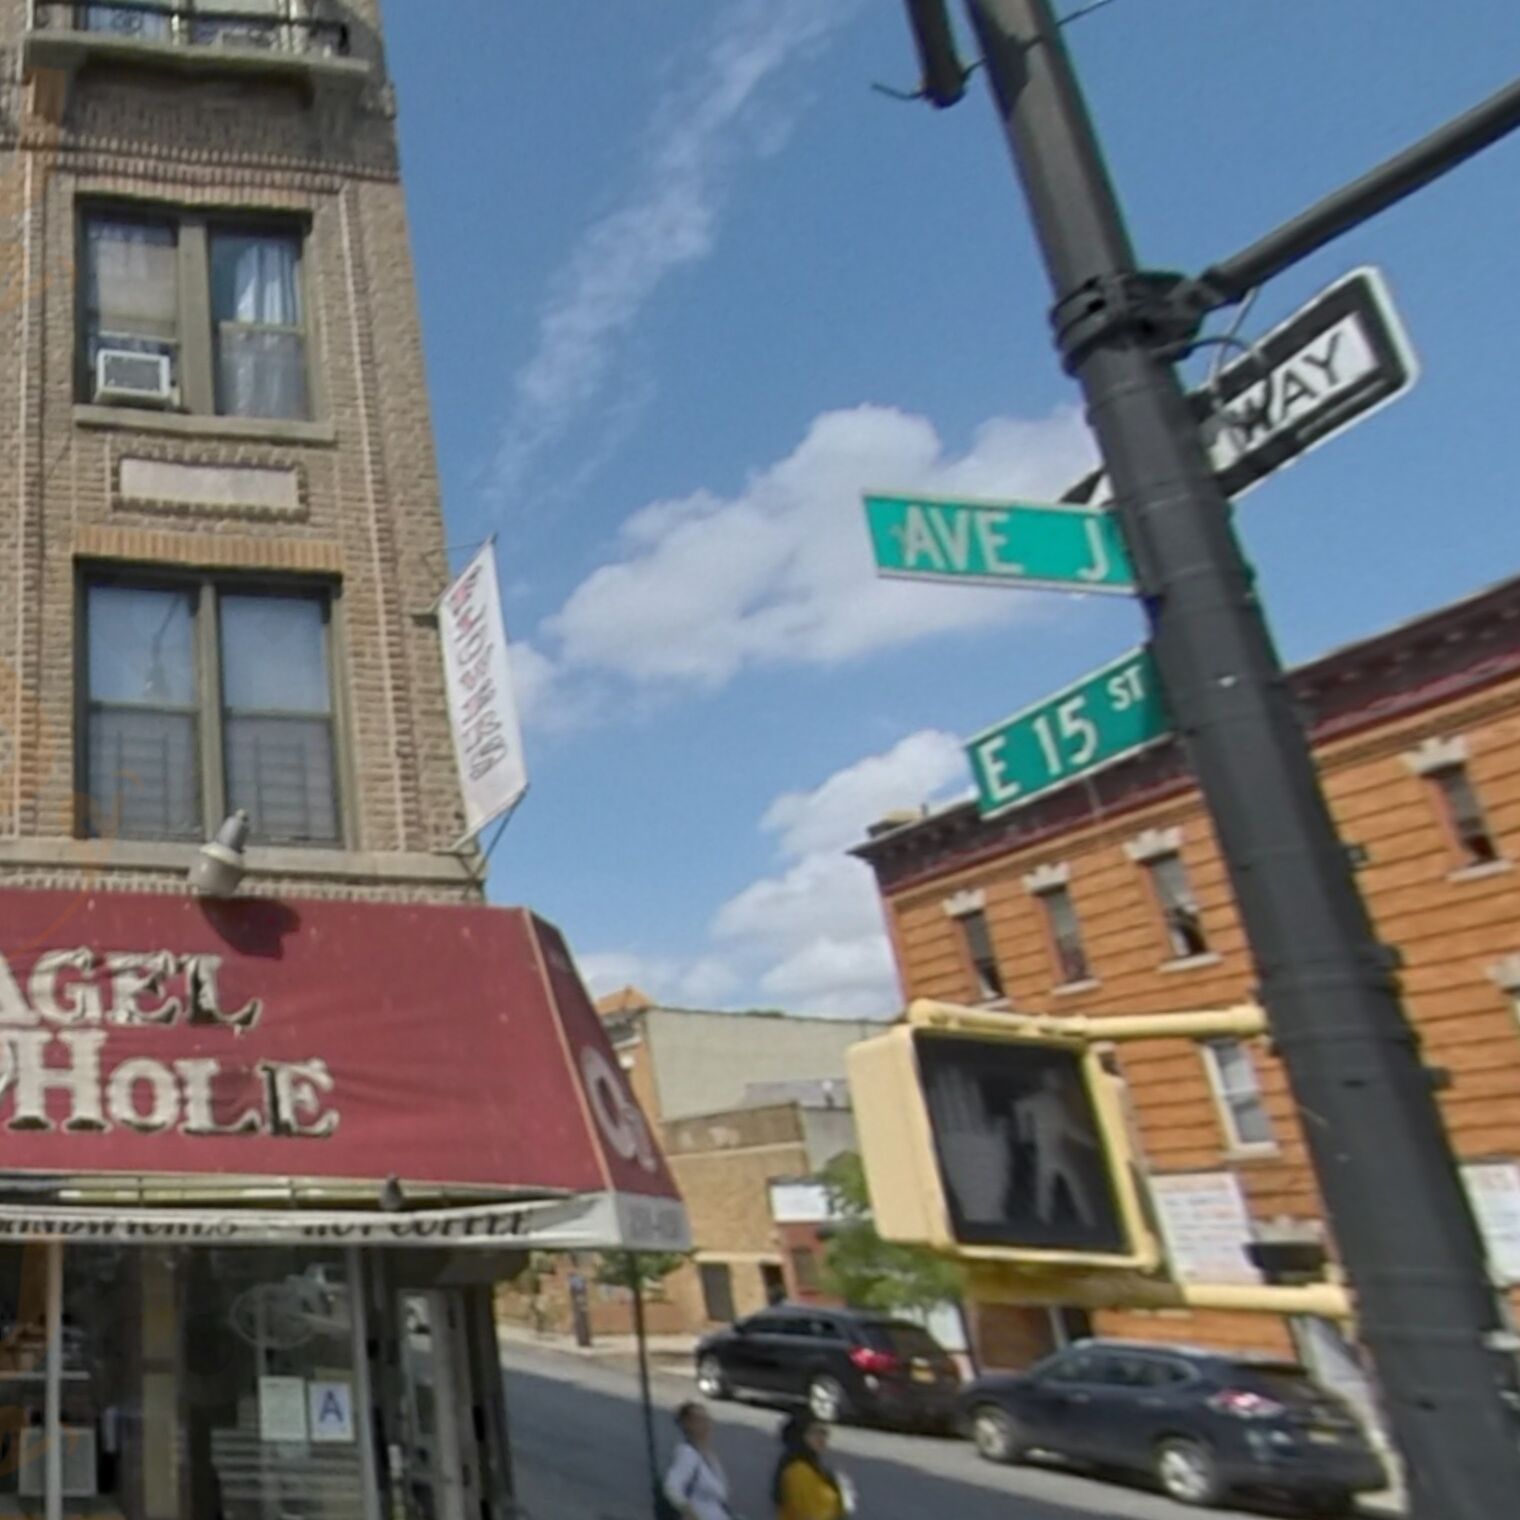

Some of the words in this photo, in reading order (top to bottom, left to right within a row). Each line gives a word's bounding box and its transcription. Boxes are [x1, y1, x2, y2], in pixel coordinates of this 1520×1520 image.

[901, 508, 1024, 575] AVE
[1077, 517, 1112, 582] J
[979, 741, 1020, 802] E
[1032, 699, 1098, 776] 15
[1107, 667, 1147, 712] ST
[4, 1028, 340, 1138] HOLE
[317, 1389, 344, 1424] A
